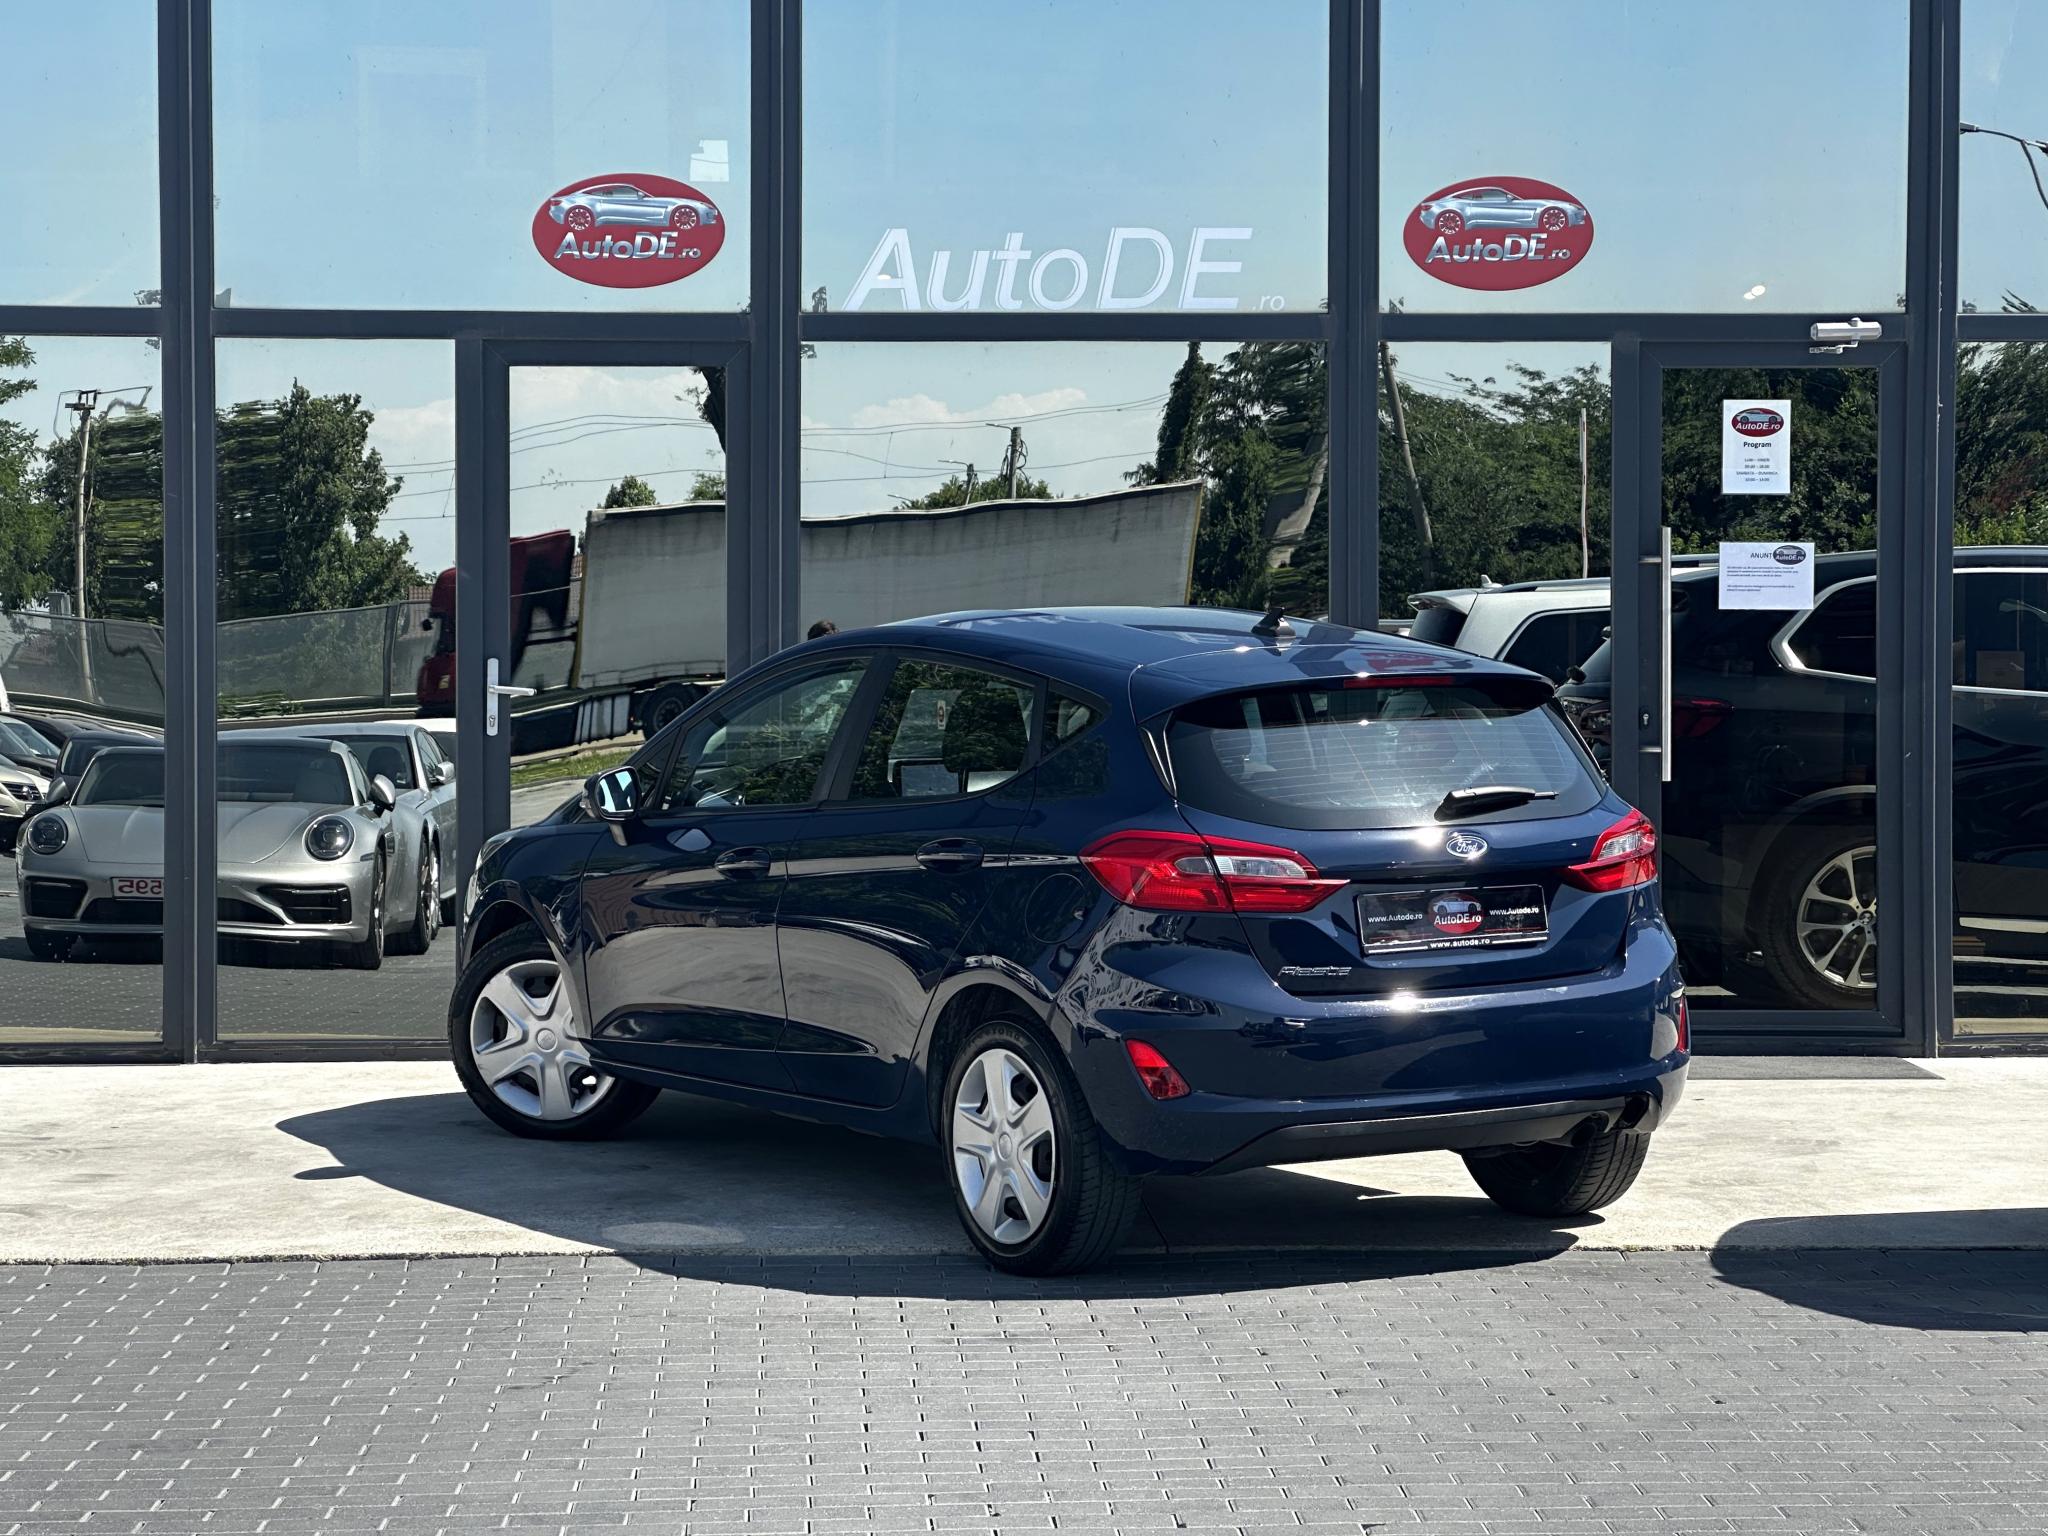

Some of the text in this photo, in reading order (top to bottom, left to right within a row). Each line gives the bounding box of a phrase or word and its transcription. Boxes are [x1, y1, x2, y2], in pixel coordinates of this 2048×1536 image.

[1735, 422, 1781, 430] AutoDE.ro
[1456, 840, 1479, 853] Ford
[1489, 906, 1540, 916] www.Autode.ro
[1367, 912, 1423, 923] www.Autode.ro
[1433, 913, 1482, 926] AutoDE.ro
[1430, 937, 1491, 949] www.autode.ro
